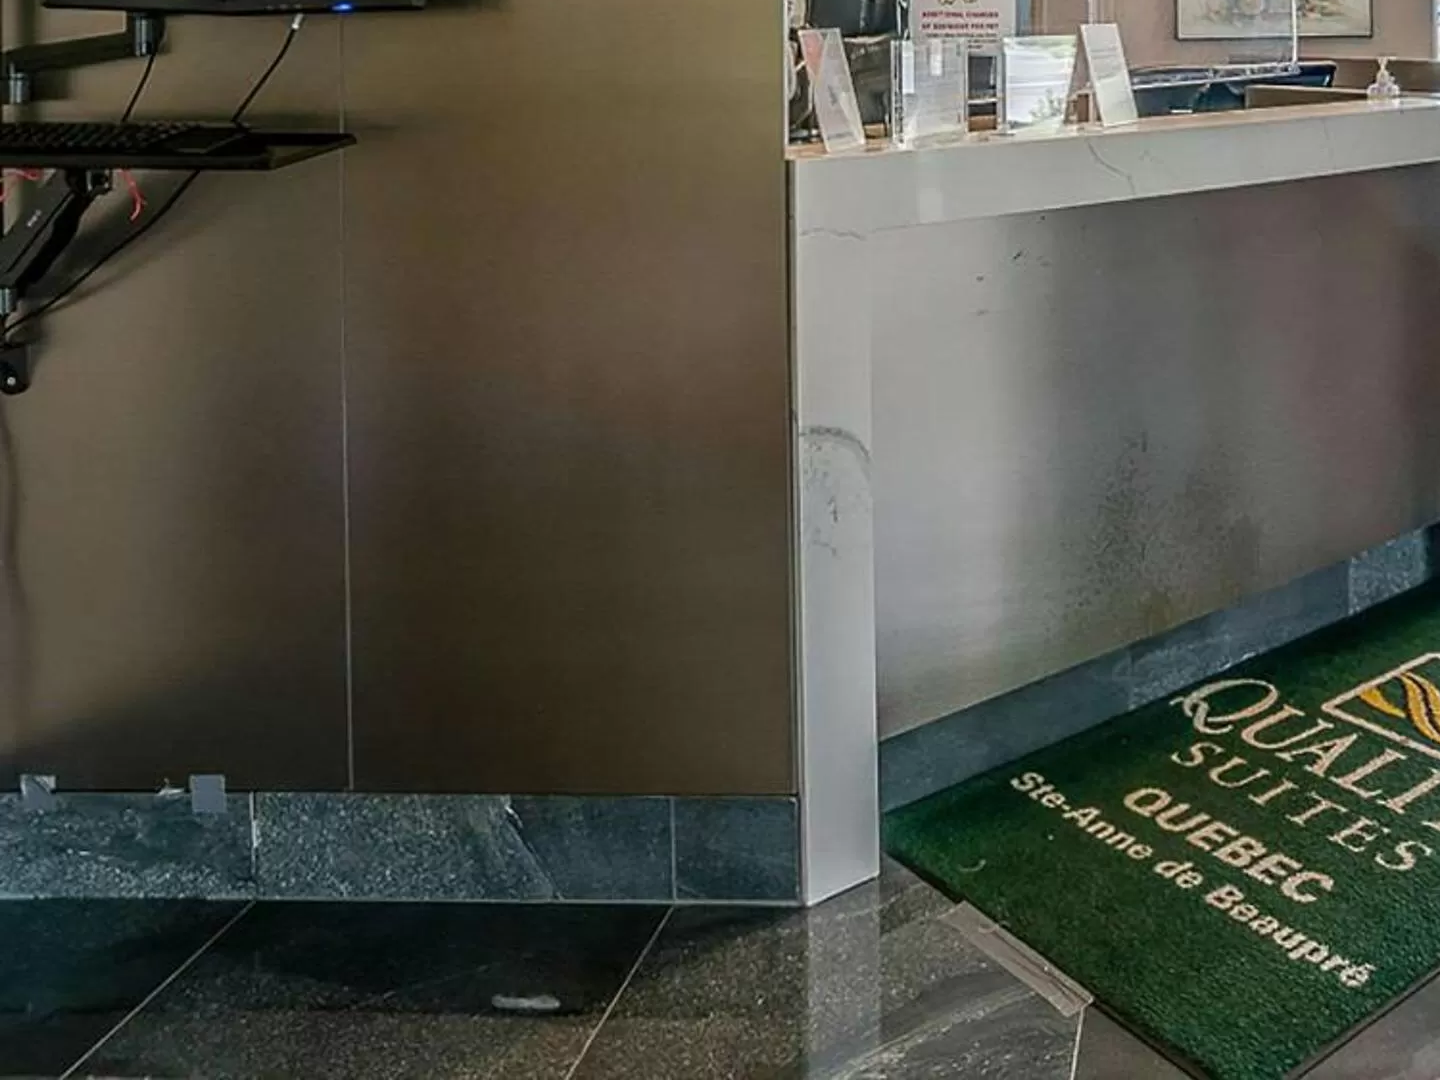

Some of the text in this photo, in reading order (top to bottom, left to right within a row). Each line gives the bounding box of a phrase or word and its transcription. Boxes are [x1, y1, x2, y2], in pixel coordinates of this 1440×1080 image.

[1122, 787, 1336, 904] QUEBEC
[1171, 741, 1432, 871] SUITES
[1010, 772, 1376, 988] Ste-Anne de Beaupré
